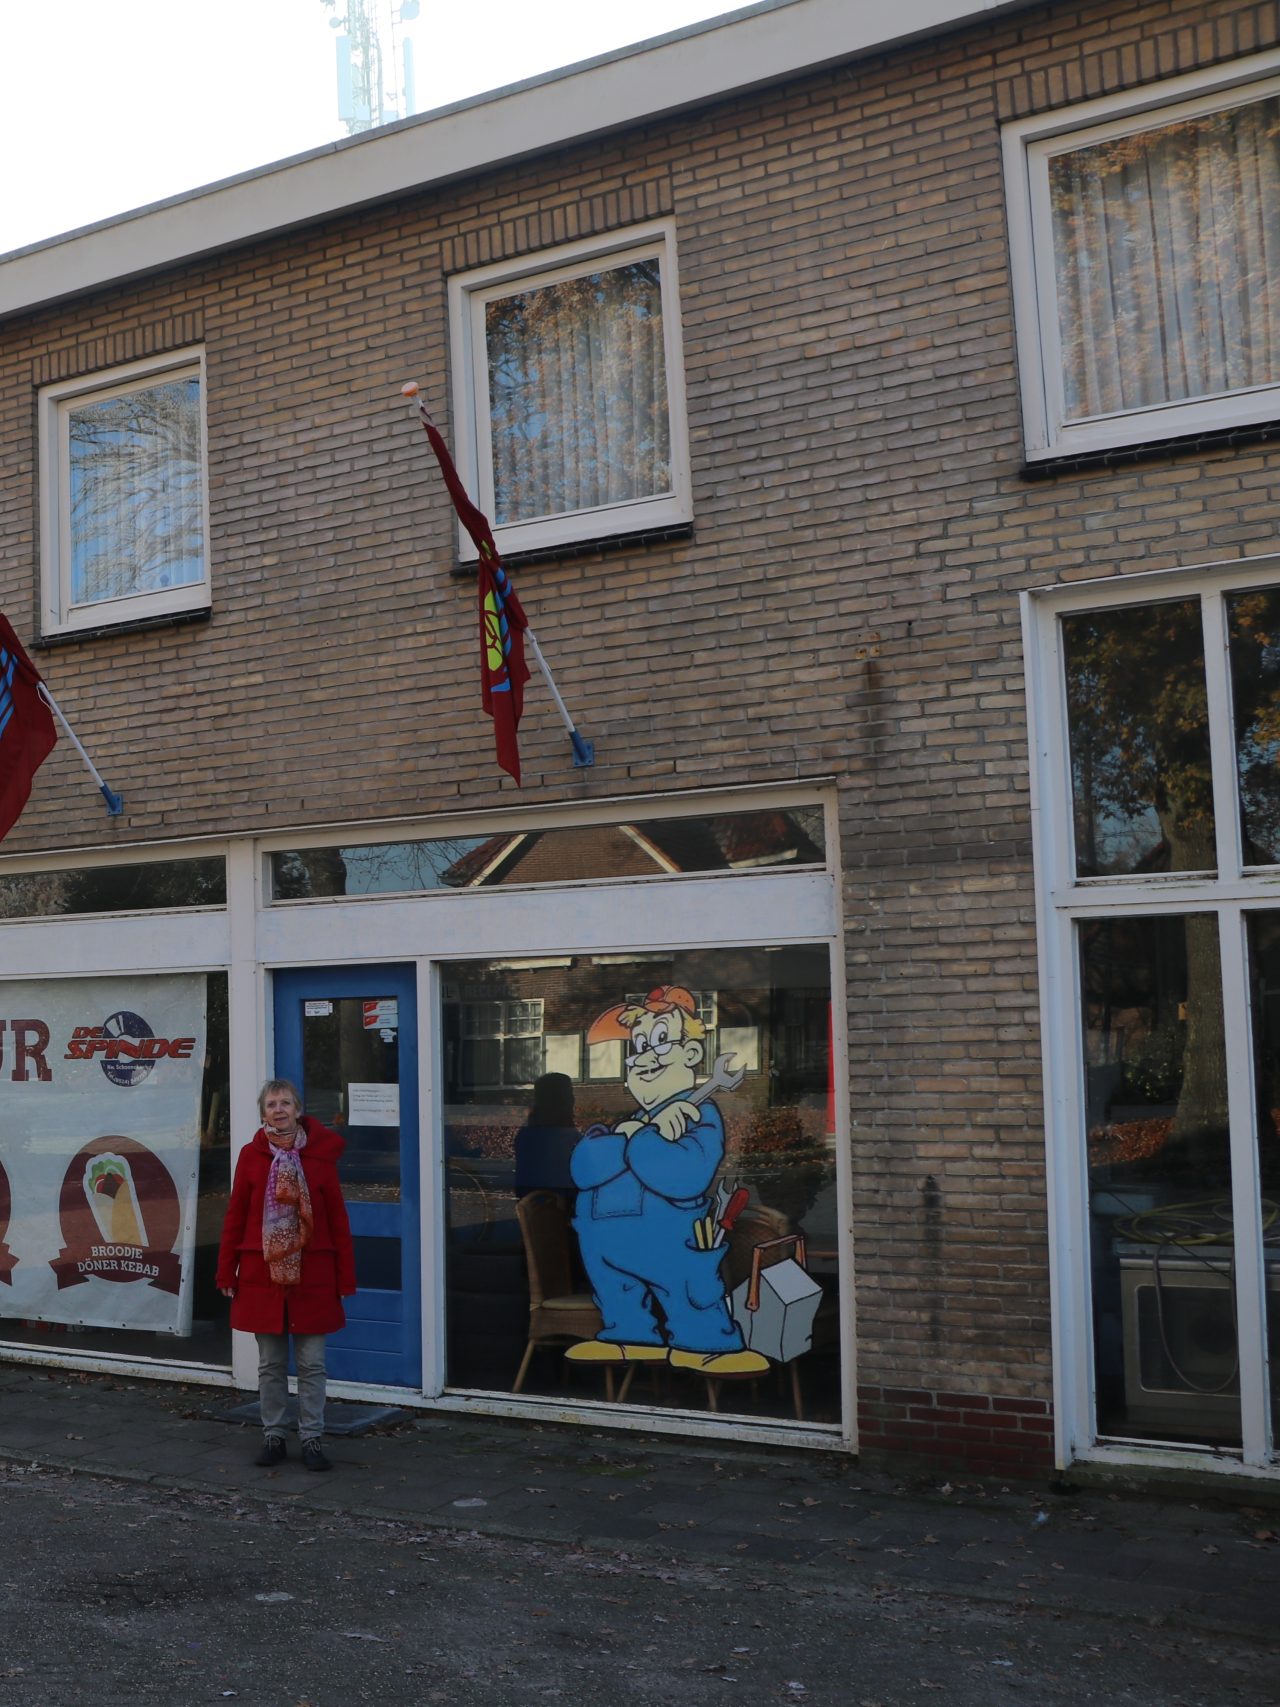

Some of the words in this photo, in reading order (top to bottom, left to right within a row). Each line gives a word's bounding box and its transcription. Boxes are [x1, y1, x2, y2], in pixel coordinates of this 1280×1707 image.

[71, 1026, 105, 1039] DE
[63, 1037, 197, 1060] SPINDE
[90, 1245, 144, 1259] BROODJE
[76, 1257, 119, 1273] DÖNER
[120, 1259, 160, 1277] KEBAB
